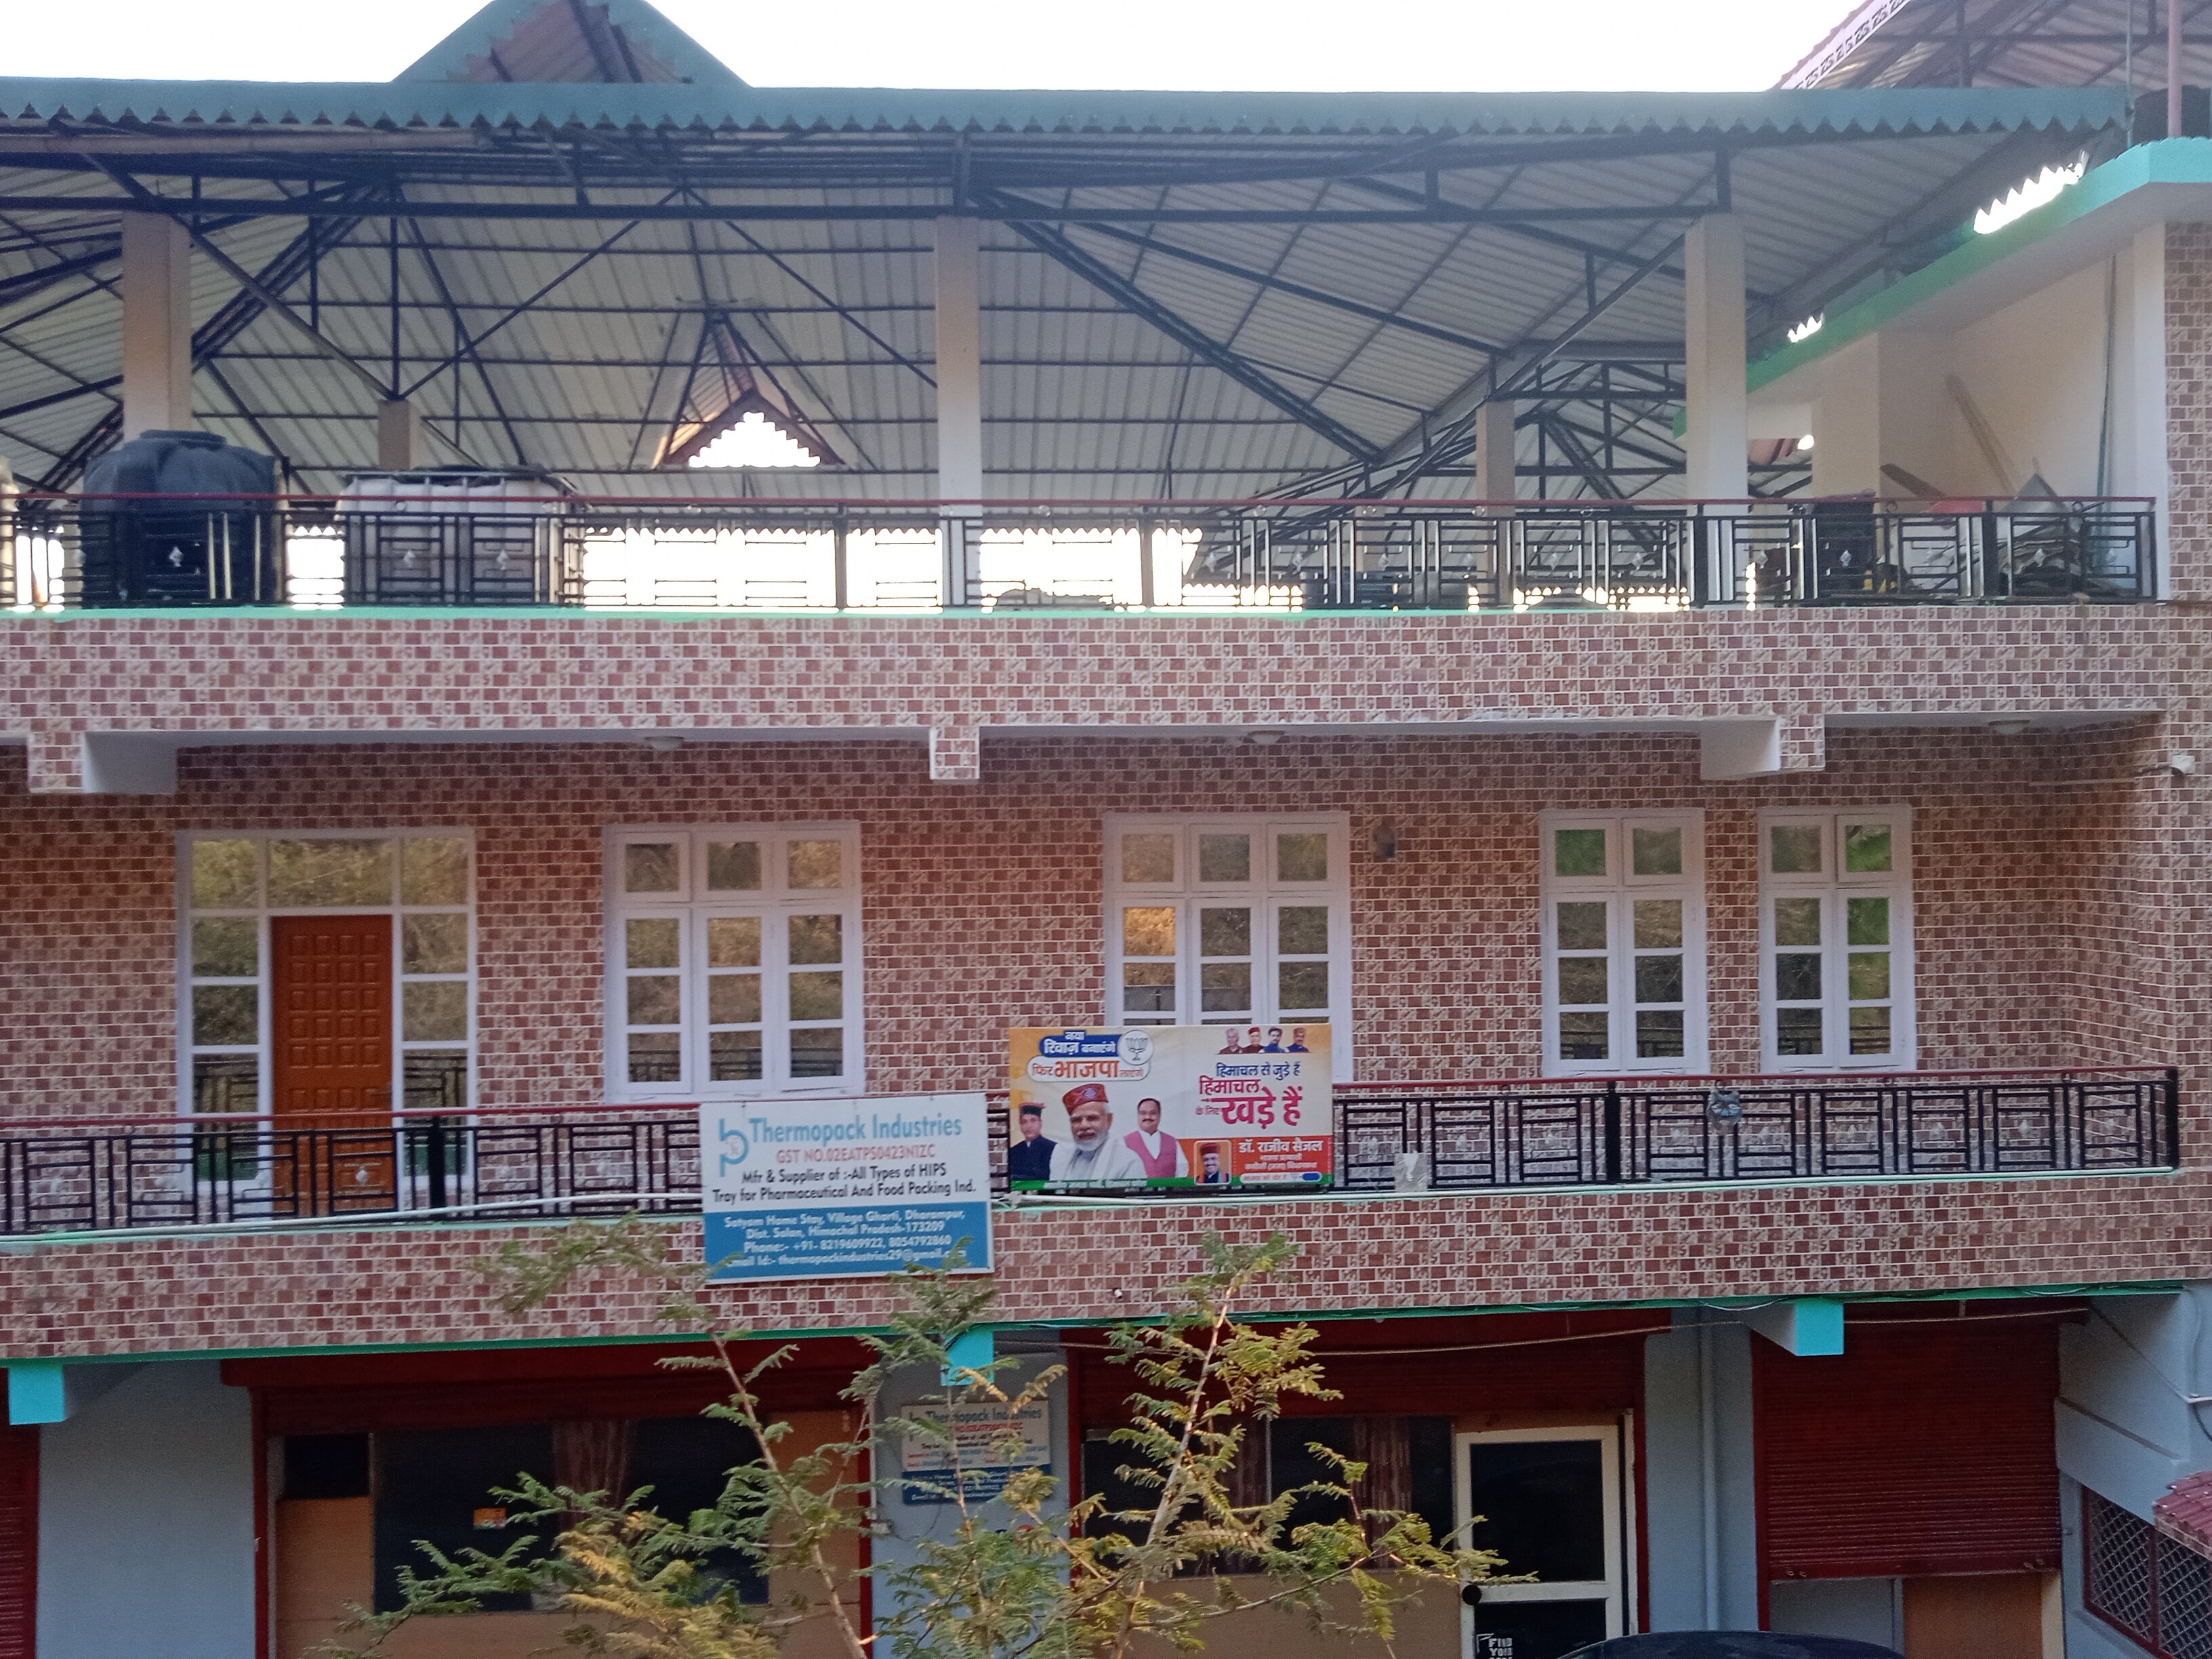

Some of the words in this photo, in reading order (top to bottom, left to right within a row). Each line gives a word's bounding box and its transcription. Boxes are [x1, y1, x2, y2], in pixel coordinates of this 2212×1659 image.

[1032, 1063, 1053, 1076] फिर
[1054, 1061, 1120, 1078] भाजपा
[1216, 1062, 1259, 1078] हिमाचल
[1261, 1061, 1271, 1076] से
[1199, 1075, 1261, 1095] हिमाचल
[1211, 1086, 1276, 1129] खड़े
[1282, 1086, 1303, 1126] हैं
[748, 1114, 866, 1147] Thermopack
[872, 1112, 962, 1139] Industries
[1257, 1138, 1290, 1153] राजीव
[1292, 1136, 1324, 1152] सैजल
[776, 1149, 801, 1164] GST
[766, 1169, 775, 1183] &
[779, 1168, 825, 1185] Supplier
[828, 1167, 841, 1181] of
[869, 1165, 901, 1182] Types
[904, 1164, 916, 1177] of
[919, 1162, 947, 1176] HIPS
[712, 1188, 737, 1206] Tray
[739, 1187, 756, 1202] for
[760, 1184, 848, 1201] Pharmaceutical
[851, 1183, 874, 1197] And
[877, 1182, 905, 1196] Food
[908, 1181, 951, 1197] Packing
[954, 1179, 977, 1193] Ind.
